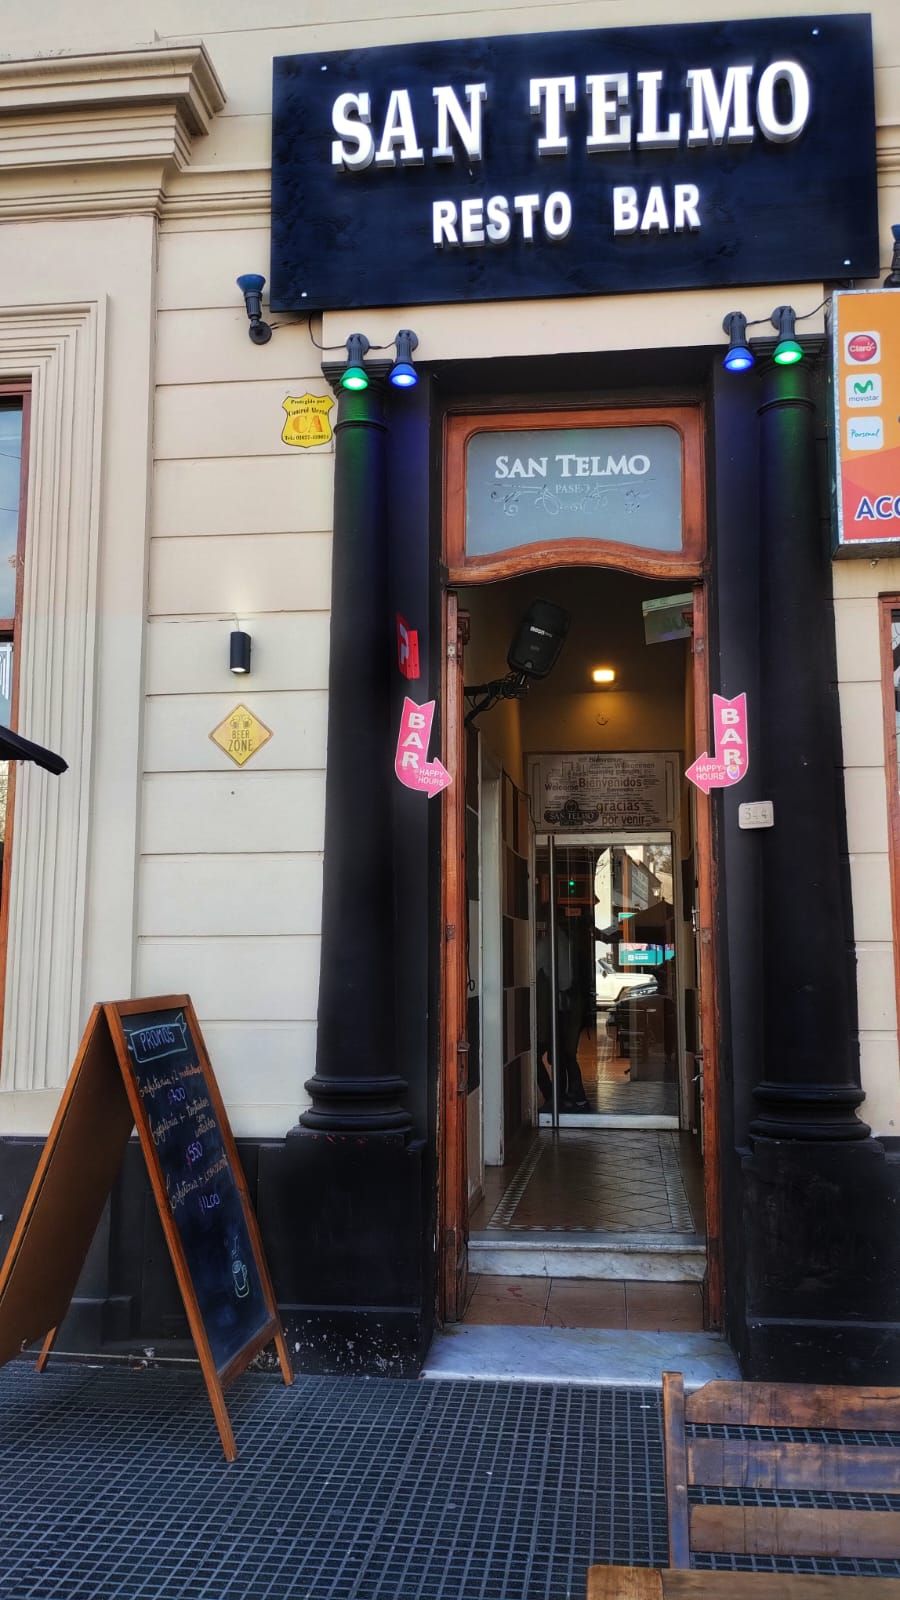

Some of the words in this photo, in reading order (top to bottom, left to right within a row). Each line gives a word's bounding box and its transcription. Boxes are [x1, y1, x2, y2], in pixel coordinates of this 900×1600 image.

[331, 84, 487, 171] SAN
[530, 61, 811, 157] TELMO
[432, 191, 572, 248] RESTO
[613, 183, 701, 236] BAR
[848, 394, 879, 402] movistar
[292, 415, 323, 433] CA
[495, 455, 548, 478] SAN
[555, 454, 650, 477] TELMO
[231, 730, 249, 739] BEER
[402, 712, 426, 769] BAR
[720, 708, 743, 765] BAR
[229, 739, 253, 752] ZONE
[420, 768, 444, 778] HAPPY
[696, 764, 720, 773] HAPPY
[418, 776, 444, 787] HOURS
[696, 772, 724, 780] HOURS
[545, 783, 579, 791] Welcome
[579, 777, 642, 788] Bienvenidos
[596, 802, 640, 813] gracias
[602, 815, 618, 826] por
[621, 813, 645, 824] venir
[140, 1027, 175, 1051] PROMOS
